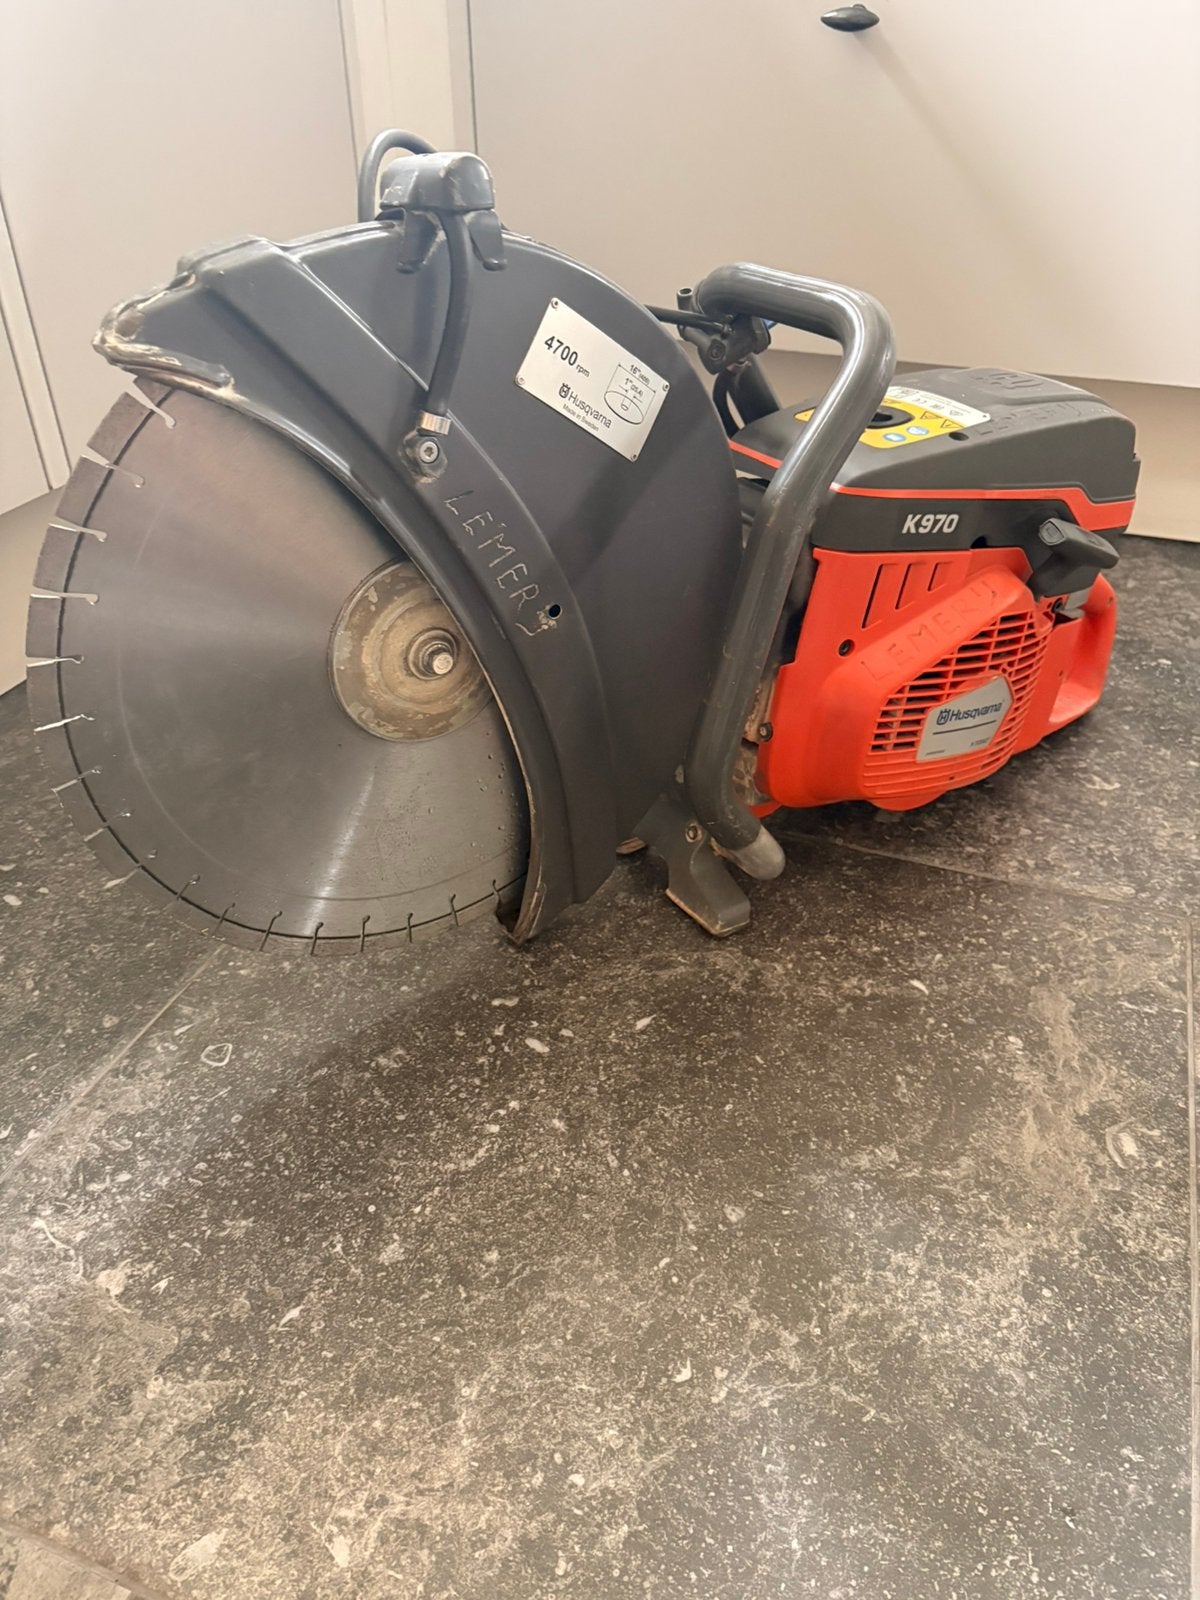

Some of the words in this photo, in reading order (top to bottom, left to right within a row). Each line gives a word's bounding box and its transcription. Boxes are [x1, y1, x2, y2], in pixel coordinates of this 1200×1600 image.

[544, 335, 578, 366] 4700
[576, 364, 590, 378] rpm
[563, 403, 576, 417] Made
[581, 415, 599, 432] Sweden
[568, 391, 612, 428] Husqvarna
[902, 513, 960, 534] K970
[950, 702, 1003, 722] Husqvarna
